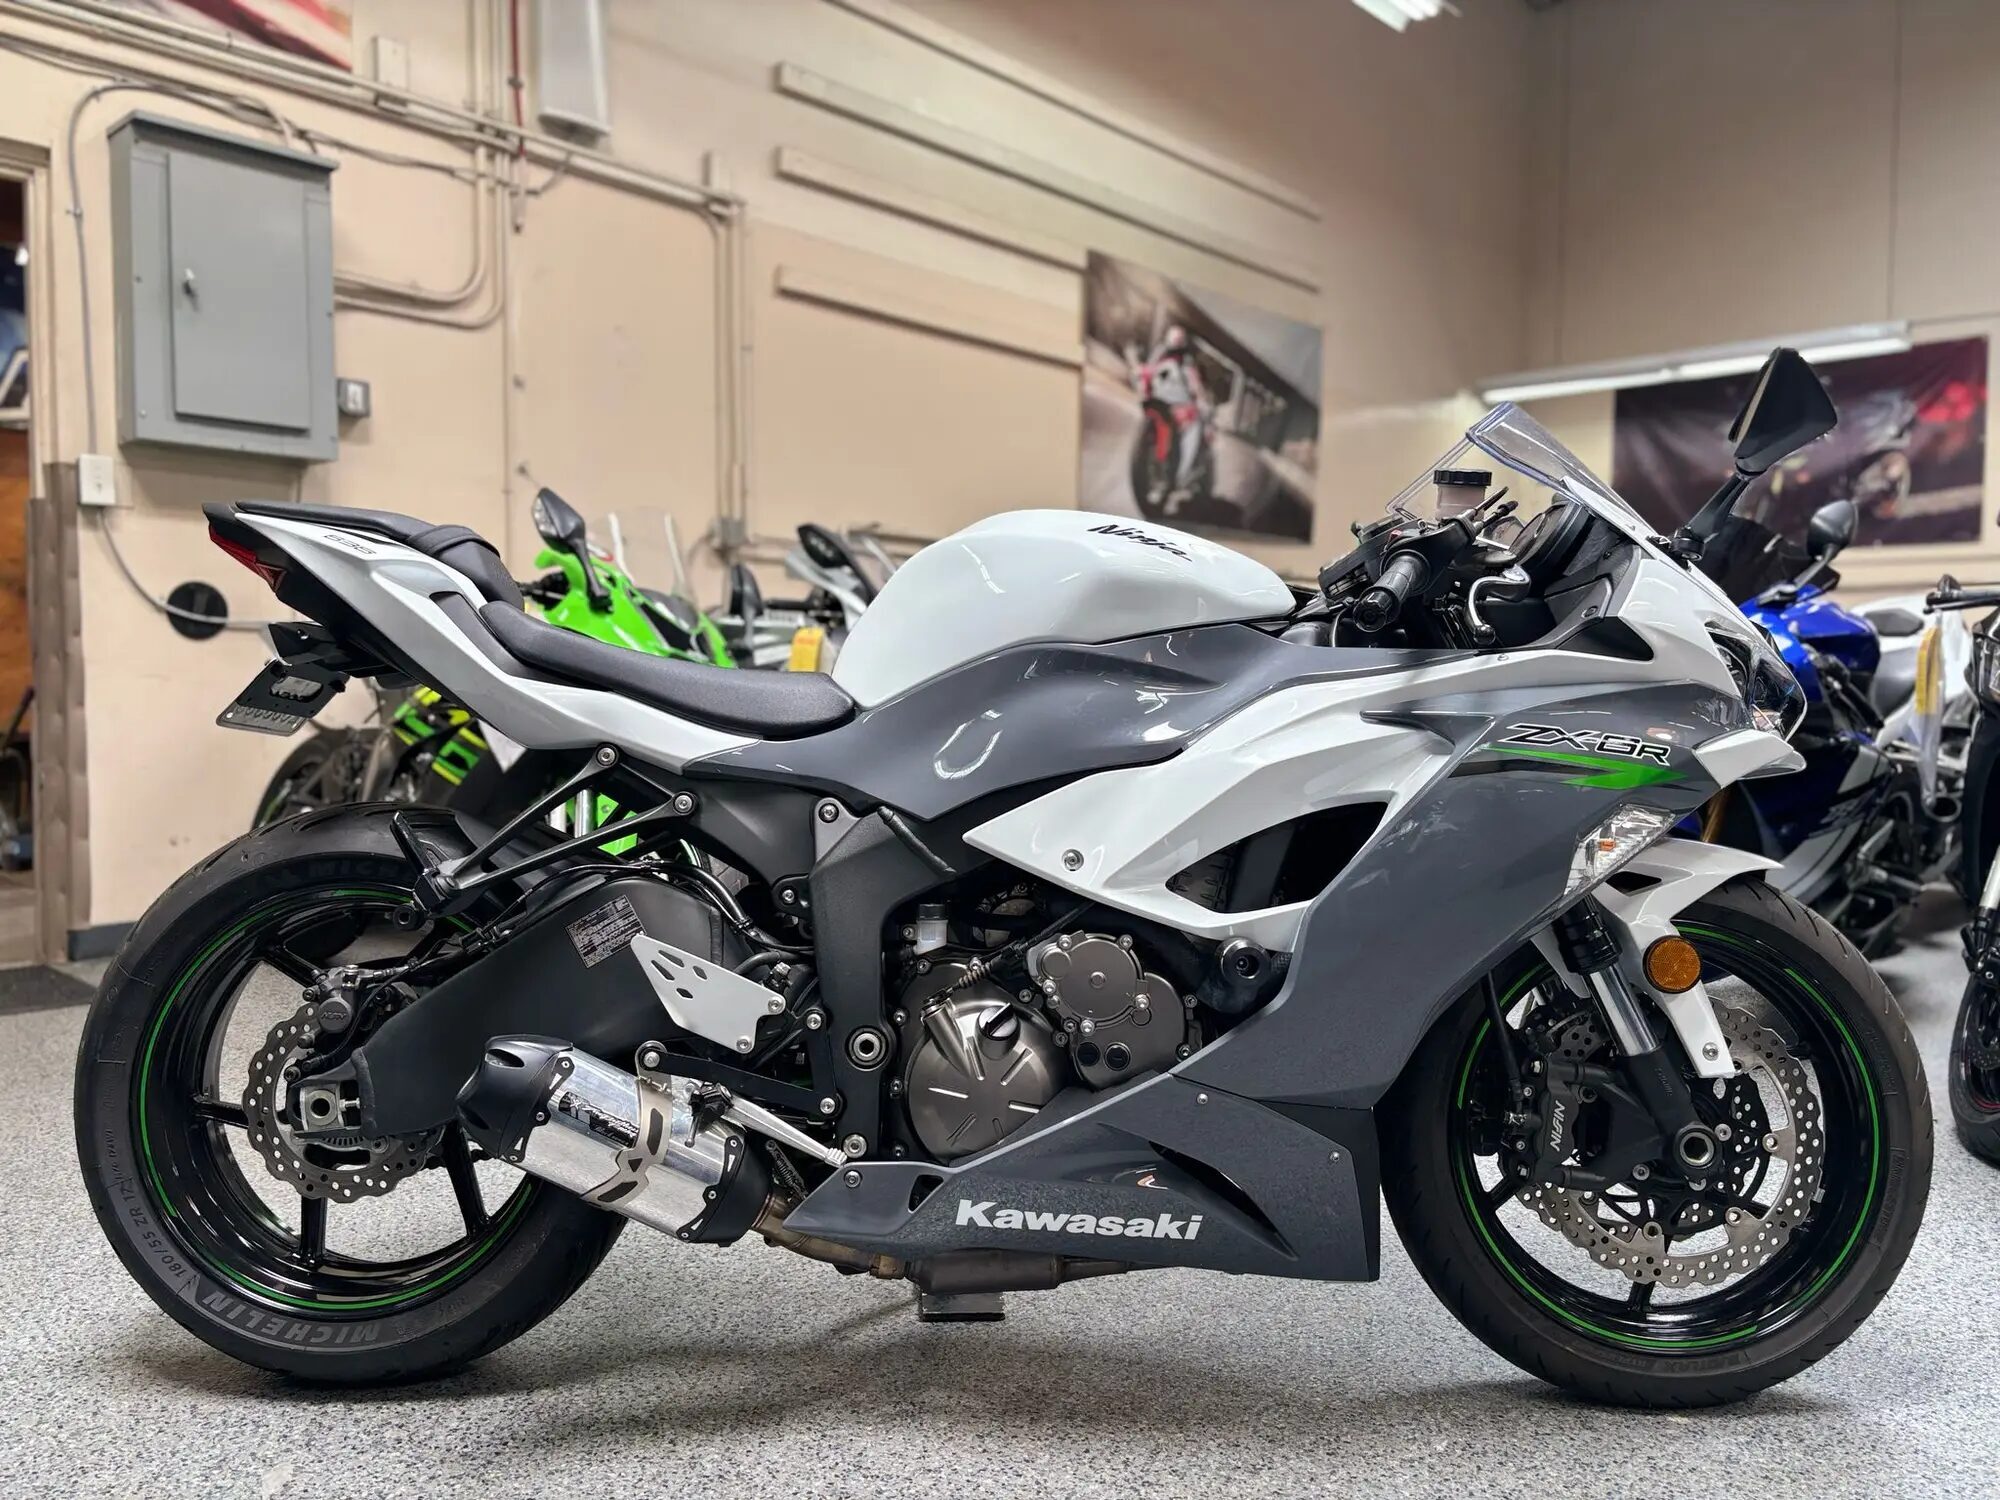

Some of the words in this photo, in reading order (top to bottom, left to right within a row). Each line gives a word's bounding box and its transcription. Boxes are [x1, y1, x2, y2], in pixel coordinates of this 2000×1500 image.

[1087, 524, 1192, 562] Ninja
[1497, 722, 1671, 766] ZX-6R
[1550, 1099, 1565, 1152] NISSIN
[129, 1207, 149, 1228] ZR
[955, 1199, 1203, 1240] Kawasaki
[143, 1231, 188, 1279] 180/55
[202, 1290, 381, 1344] MICHELIN
